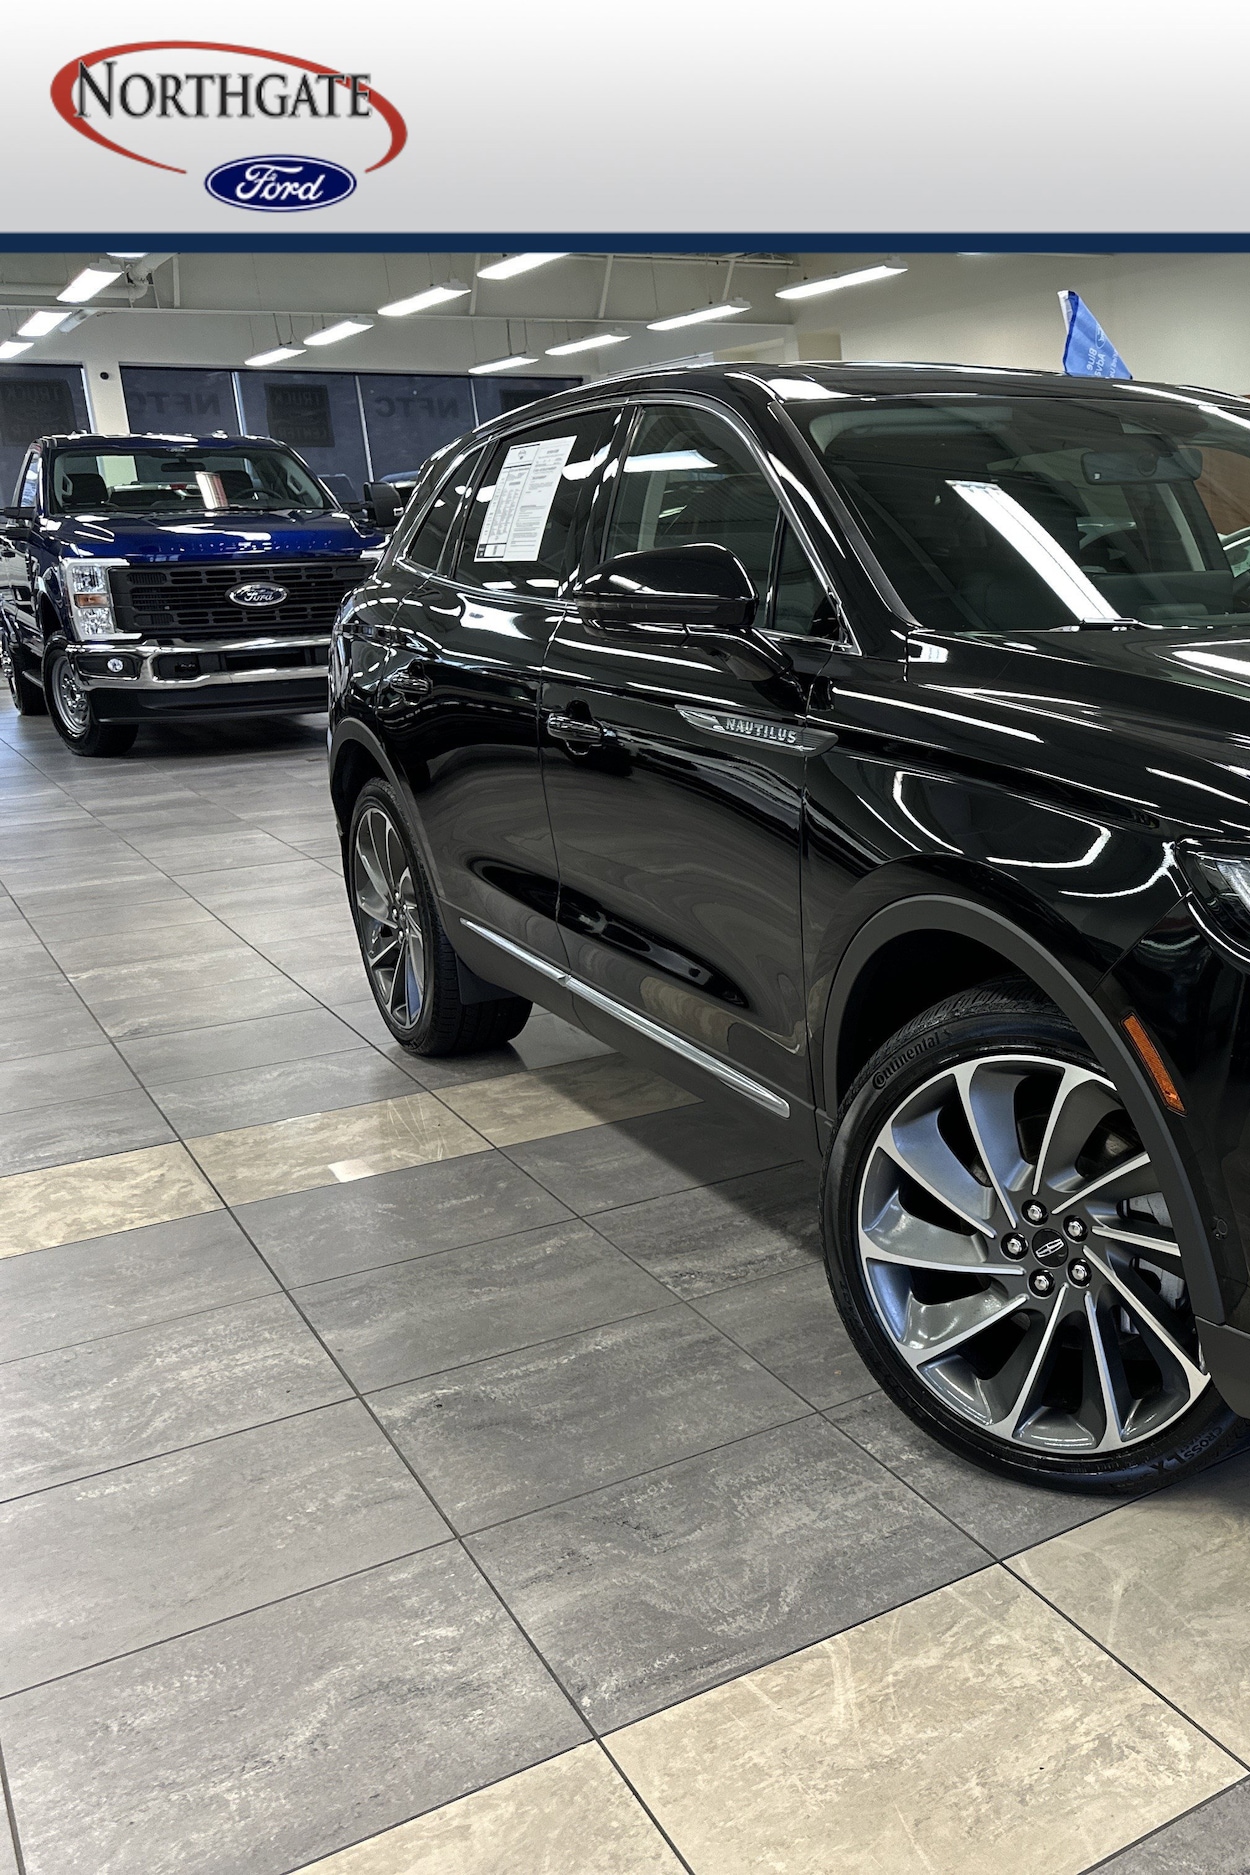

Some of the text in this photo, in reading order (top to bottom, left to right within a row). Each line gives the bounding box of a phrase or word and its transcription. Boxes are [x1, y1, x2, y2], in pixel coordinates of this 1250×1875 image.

[244, 590, 274, 602] Ford
[725, 717, 798, 744] NAUTILUS
[872, 1031, 941, 1090] Continental
[1183, 1426, 1223, 1460] CROSS
